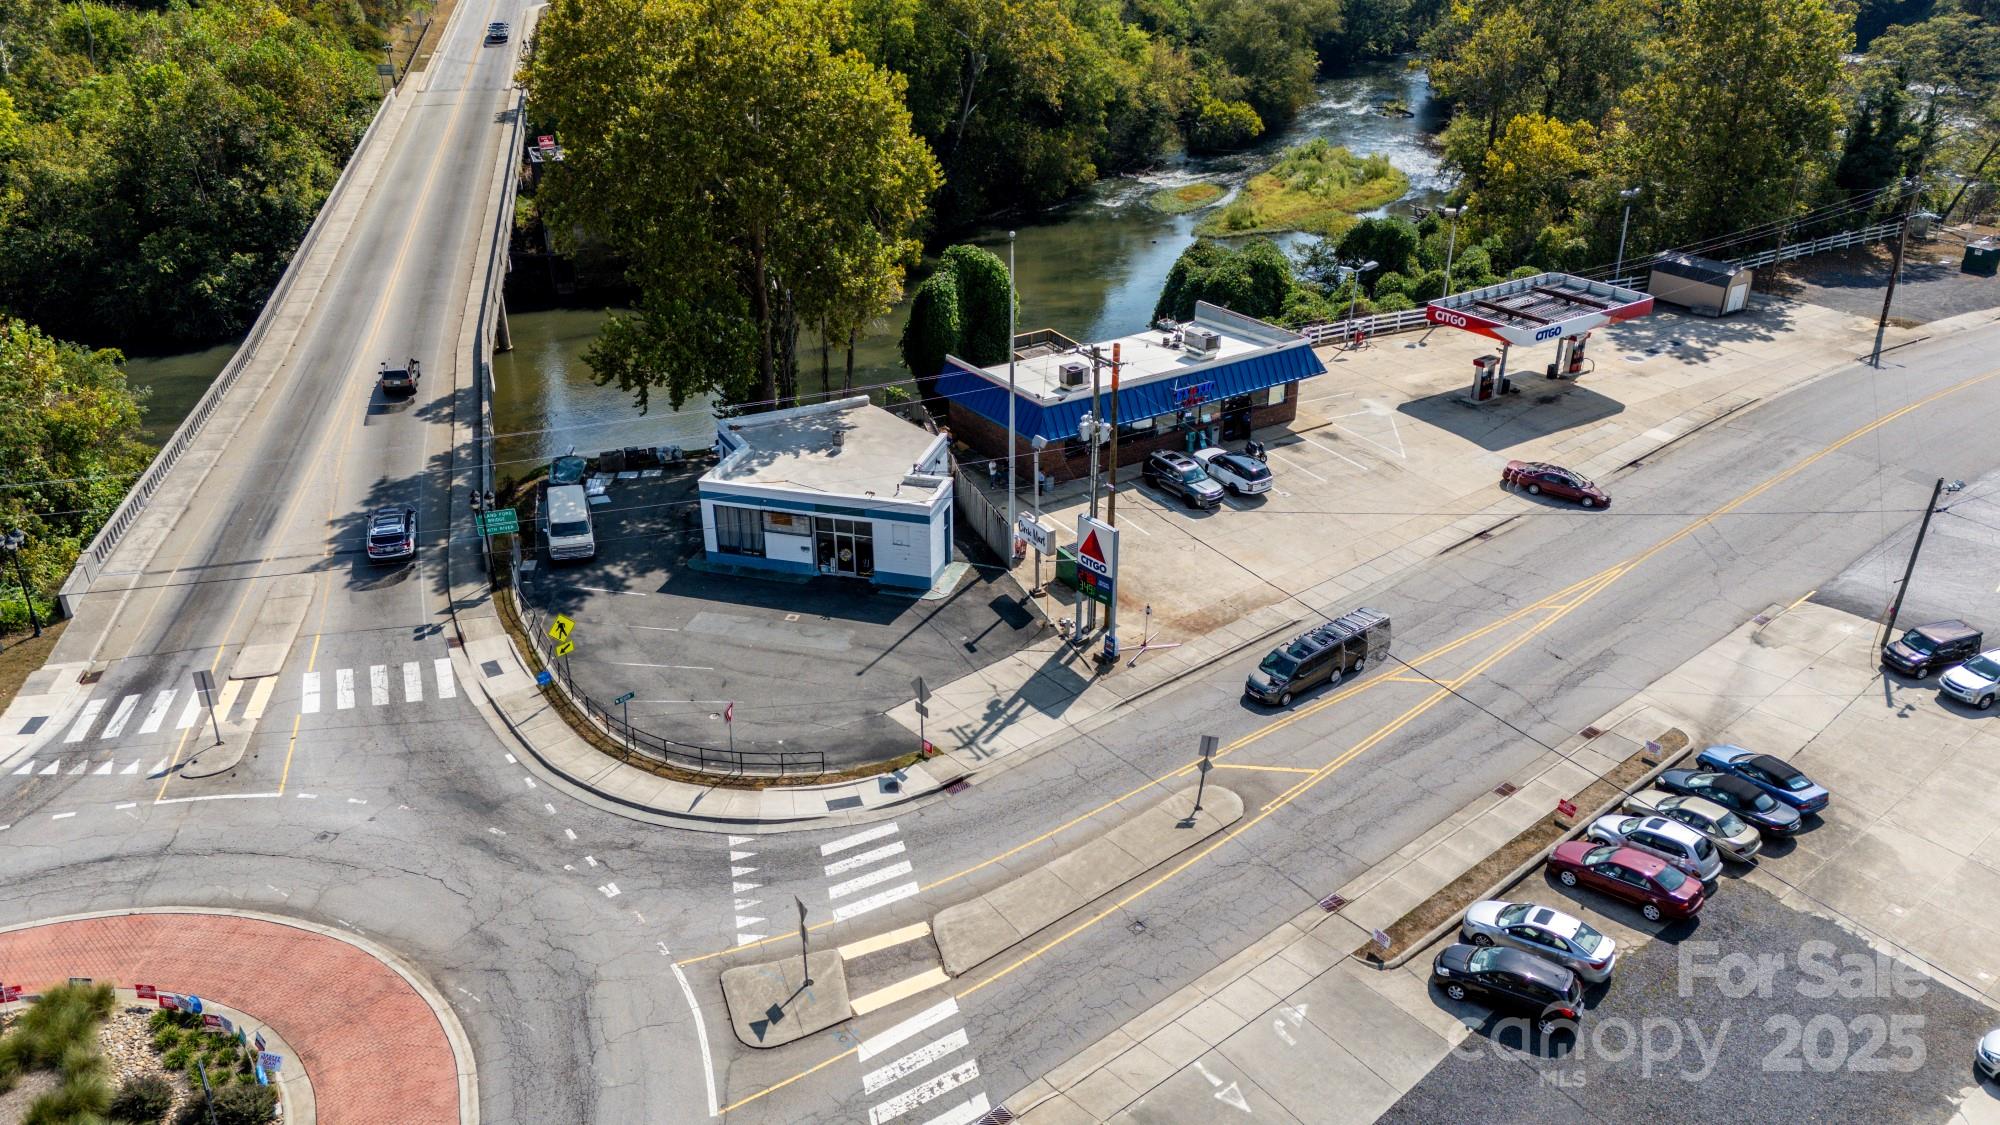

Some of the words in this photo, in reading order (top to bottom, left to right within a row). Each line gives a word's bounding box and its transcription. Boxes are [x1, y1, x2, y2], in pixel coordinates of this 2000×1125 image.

[1435, 310, 1467, 327] CITGO
[1535, 326, 1562, 341] CITGO
[1018, 519, 1031, 536] Circle
[1031, 527, 1046, 547] Mart
[1081, 555, 1107, 574] CITGO
